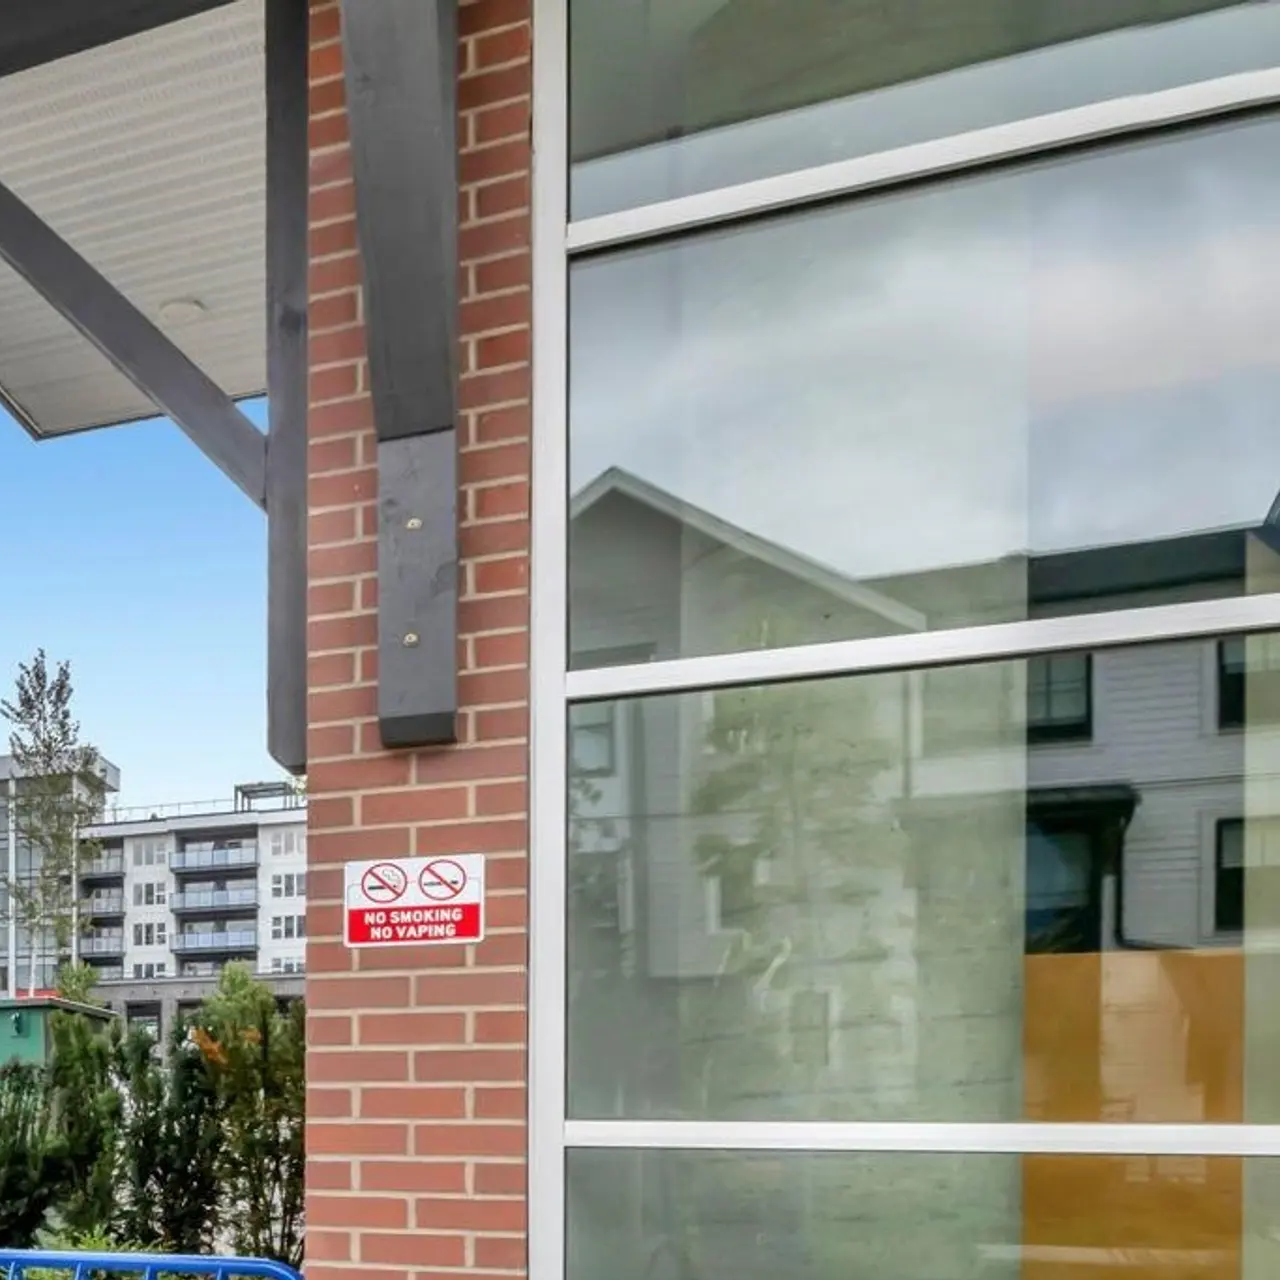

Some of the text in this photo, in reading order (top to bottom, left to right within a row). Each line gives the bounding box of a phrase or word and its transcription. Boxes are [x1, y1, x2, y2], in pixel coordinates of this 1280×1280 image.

[364, 908, 463, 926] NO SMOKING
[370, 924, 457, 940] NO VAPING
